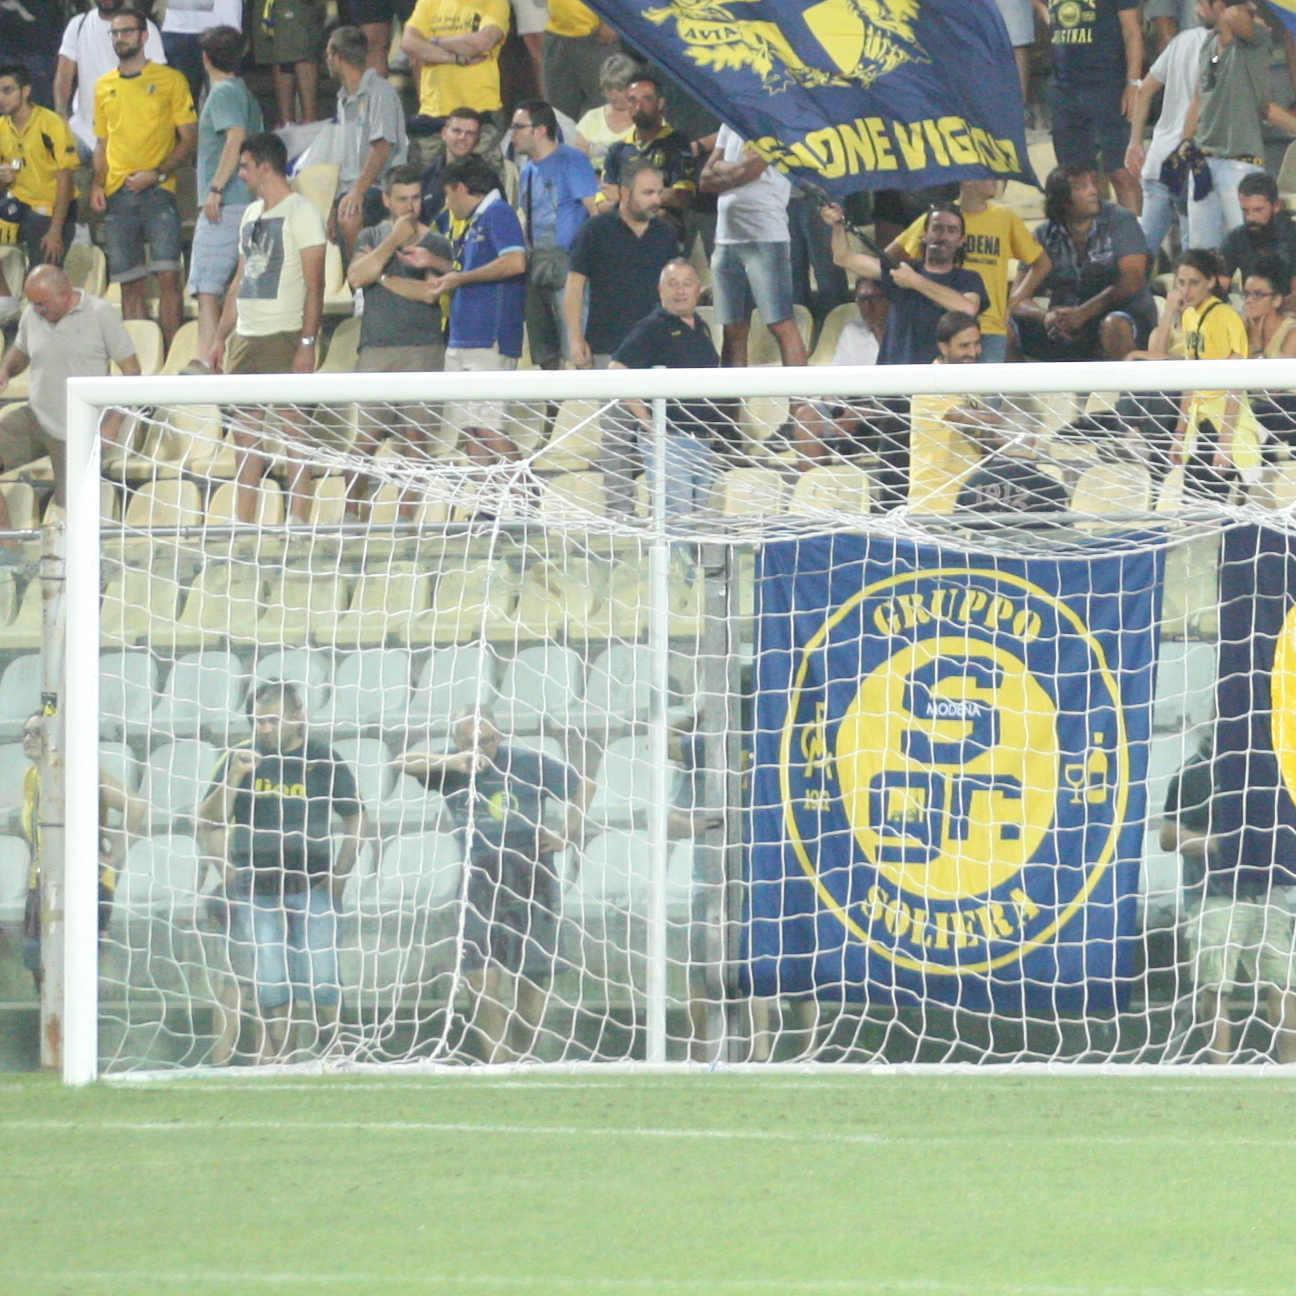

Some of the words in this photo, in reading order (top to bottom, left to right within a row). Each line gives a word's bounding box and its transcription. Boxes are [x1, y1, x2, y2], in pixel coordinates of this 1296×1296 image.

[965, 233, 1000, 257] DENA
[873, 588, 1042, 644] GRUPPO
[926, 698, 981, 718] MODENA
[861, 884, 1041, 950] SOLIERA
